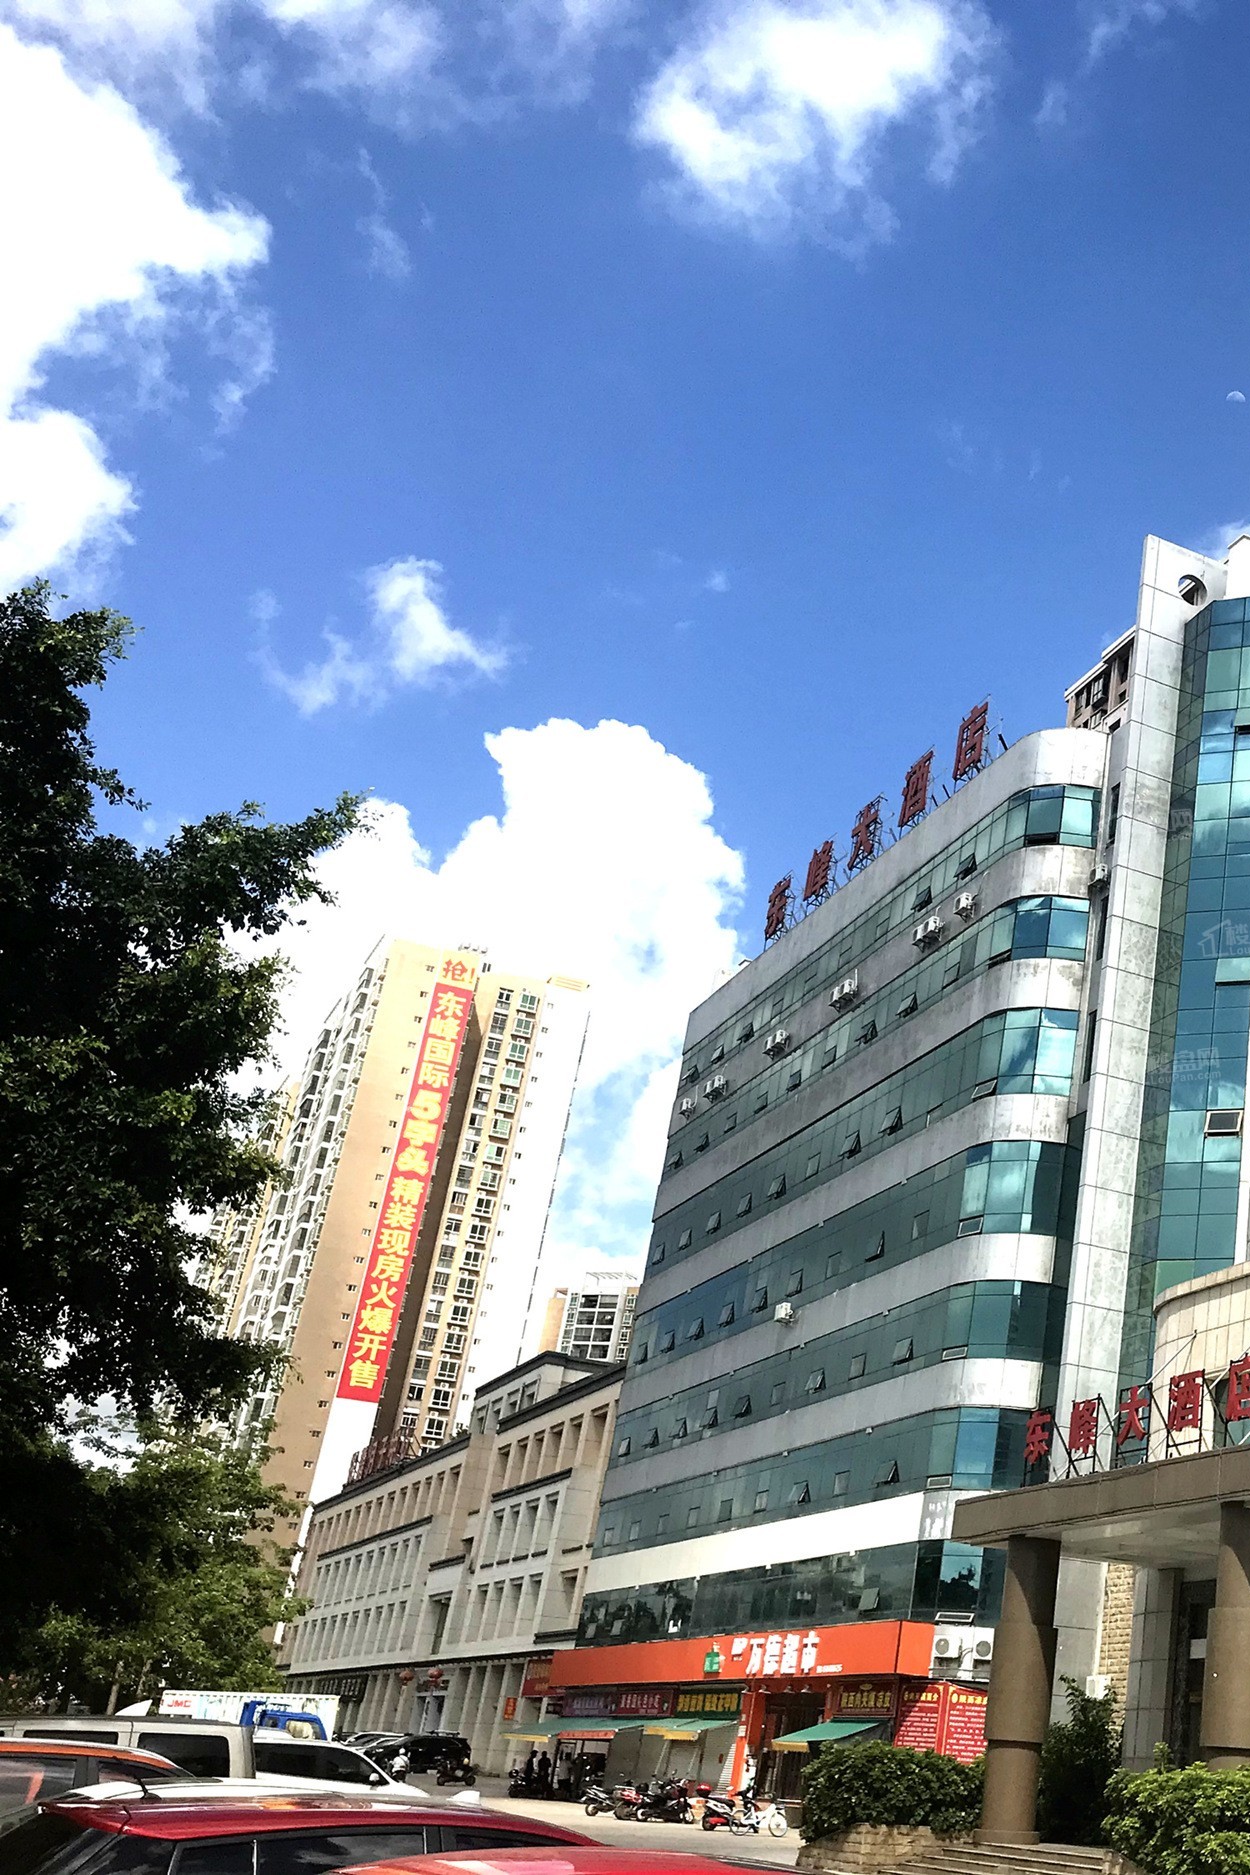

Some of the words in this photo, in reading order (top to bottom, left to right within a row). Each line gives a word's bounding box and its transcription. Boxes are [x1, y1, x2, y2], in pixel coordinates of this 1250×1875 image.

[764, 701, 989, 941] 东峰大酒店
[167, 1699, 192, 1708] JMC
